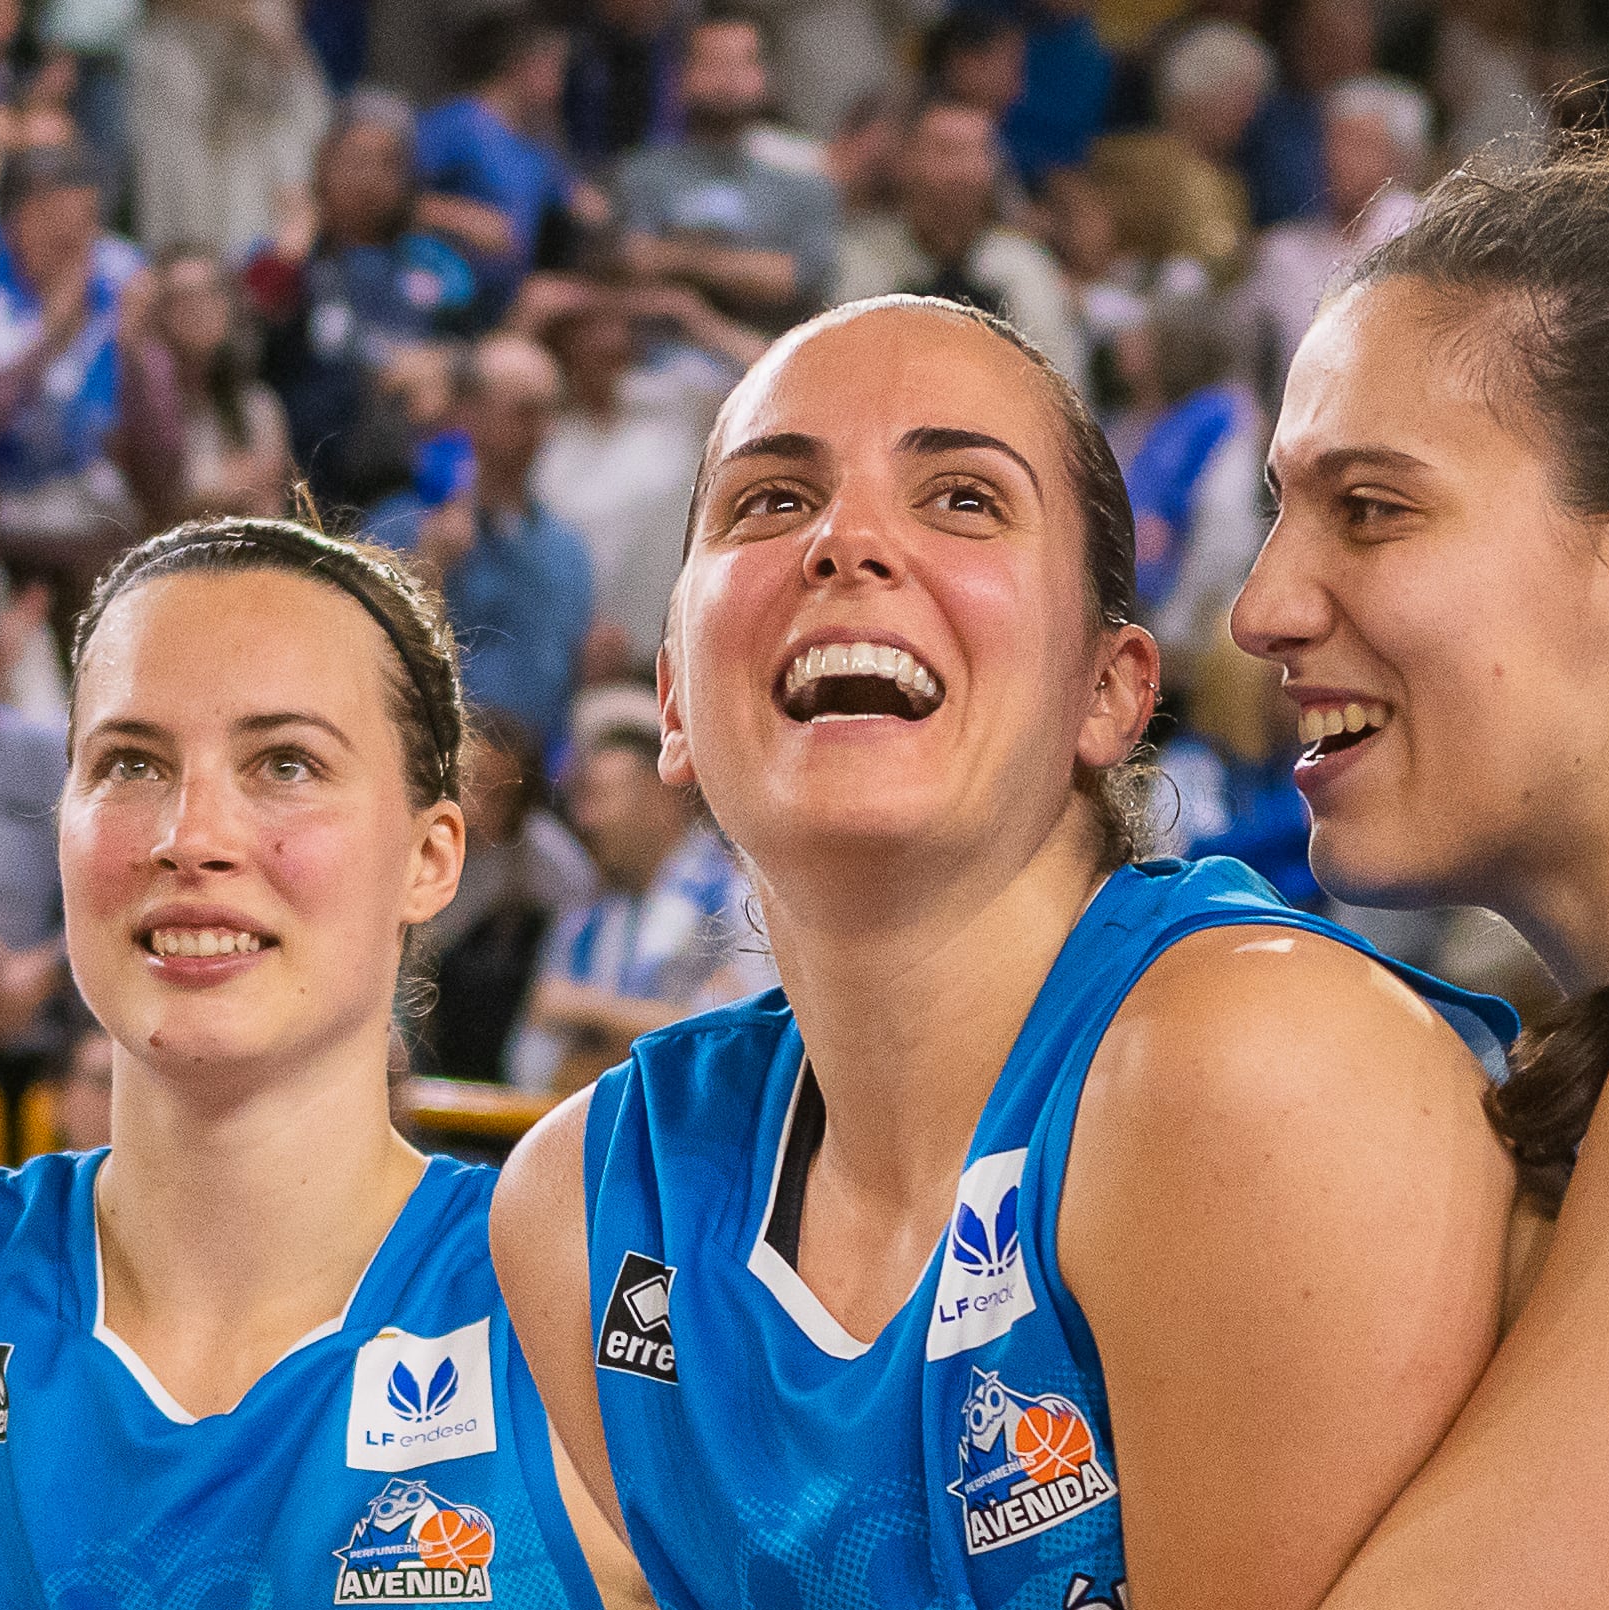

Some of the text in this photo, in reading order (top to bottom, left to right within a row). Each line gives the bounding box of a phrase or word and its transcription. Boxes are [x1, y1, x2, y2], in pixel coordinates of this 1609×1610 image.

[940, 1297, 970, 1323] LF
[606, 1330, 675, 1372] erre
[365, 1418, 478, 1448] LF endesa
[969, 1463, 1110, 1546] AVENIDA
[342, 1567, 485, 1598] AVENIDA
